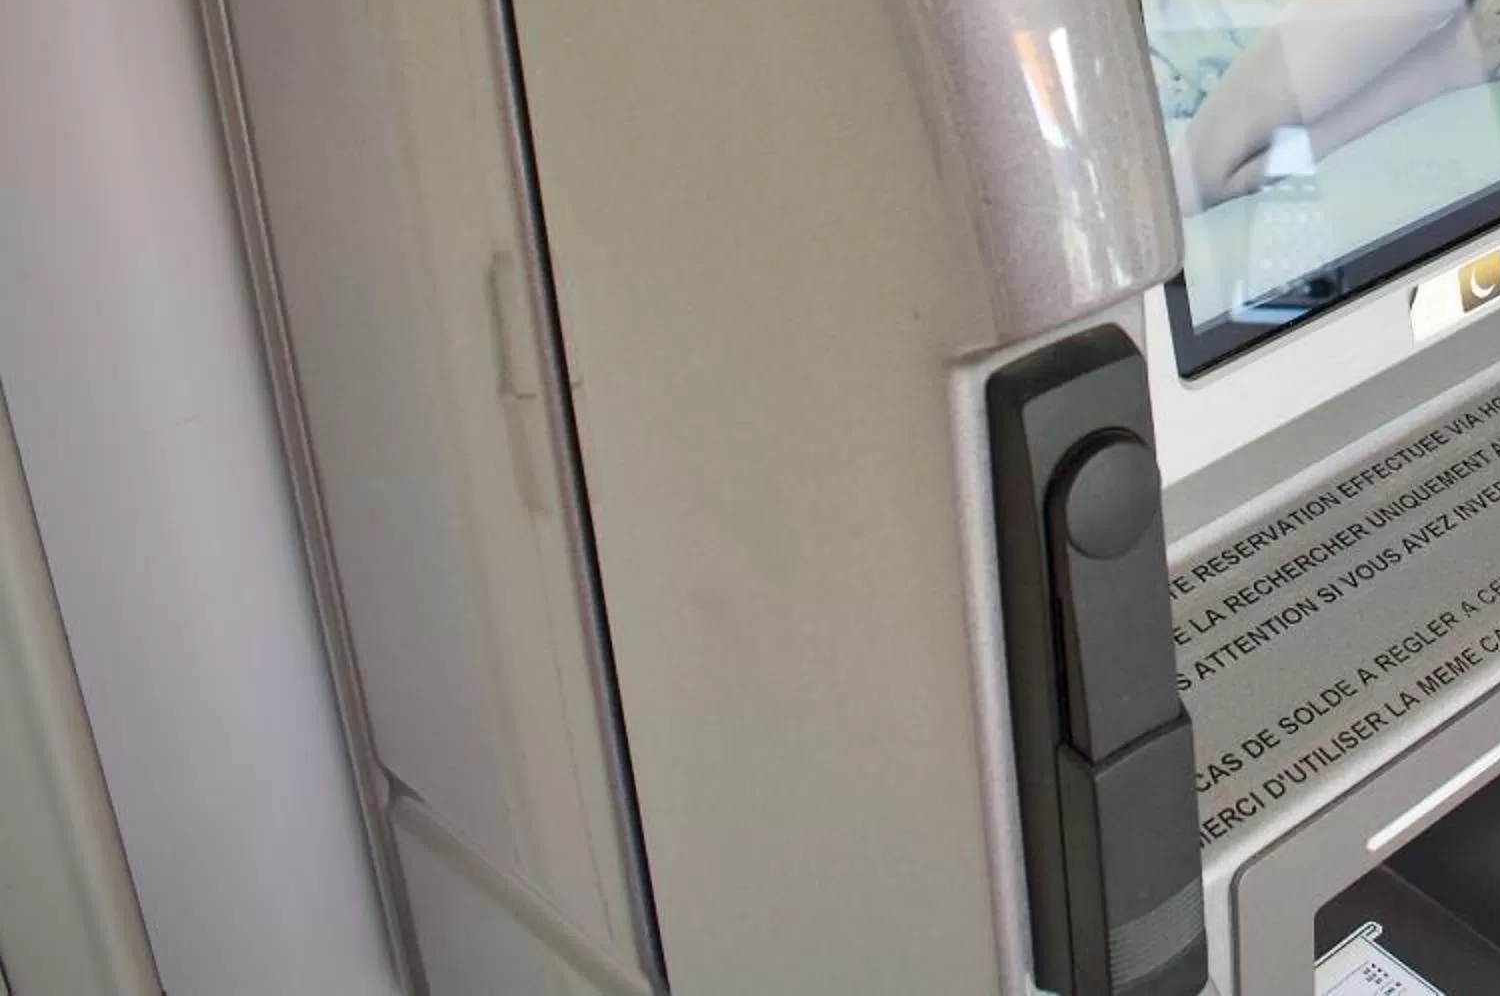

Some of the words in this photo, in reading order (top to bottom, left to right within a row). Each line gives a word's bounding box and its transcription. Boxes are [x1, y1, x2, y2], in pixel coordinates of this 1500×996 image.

[1188, 608, 1228, 634] LA
[1223, 521, 1371, 615] RECHERCHER
[1365, 448, 1495, 530] UNIQUEMENT
[1191, 492, 1342, 584] RESERVATION
[1336, 431, 1450, 500] EFFECTUEE
[1445, 407, 1483, 438] VIA
[1194, 597, 1321, 681] ATTENTION
[1315, 582, 1346, 607] SI
[1339, 547, 1404, 590] VOUS
[1402, 512, 1457, 556] AVEZ
[1194, 753, 1243, 793] CAS
[1242, 728, 1281, 760] DE
[1278, 680, 1358, 736] SOLDE
[1358, 666, 1380, 686] A
[1373, 610, 1460, 674] REGLER
[1461, 599, 1480, 621] A
[1262, 713, 1386, 800] D'UTILISER
[1384, 692, 1421, 725] LA
[1416, 645, 1483, 695] MEME
